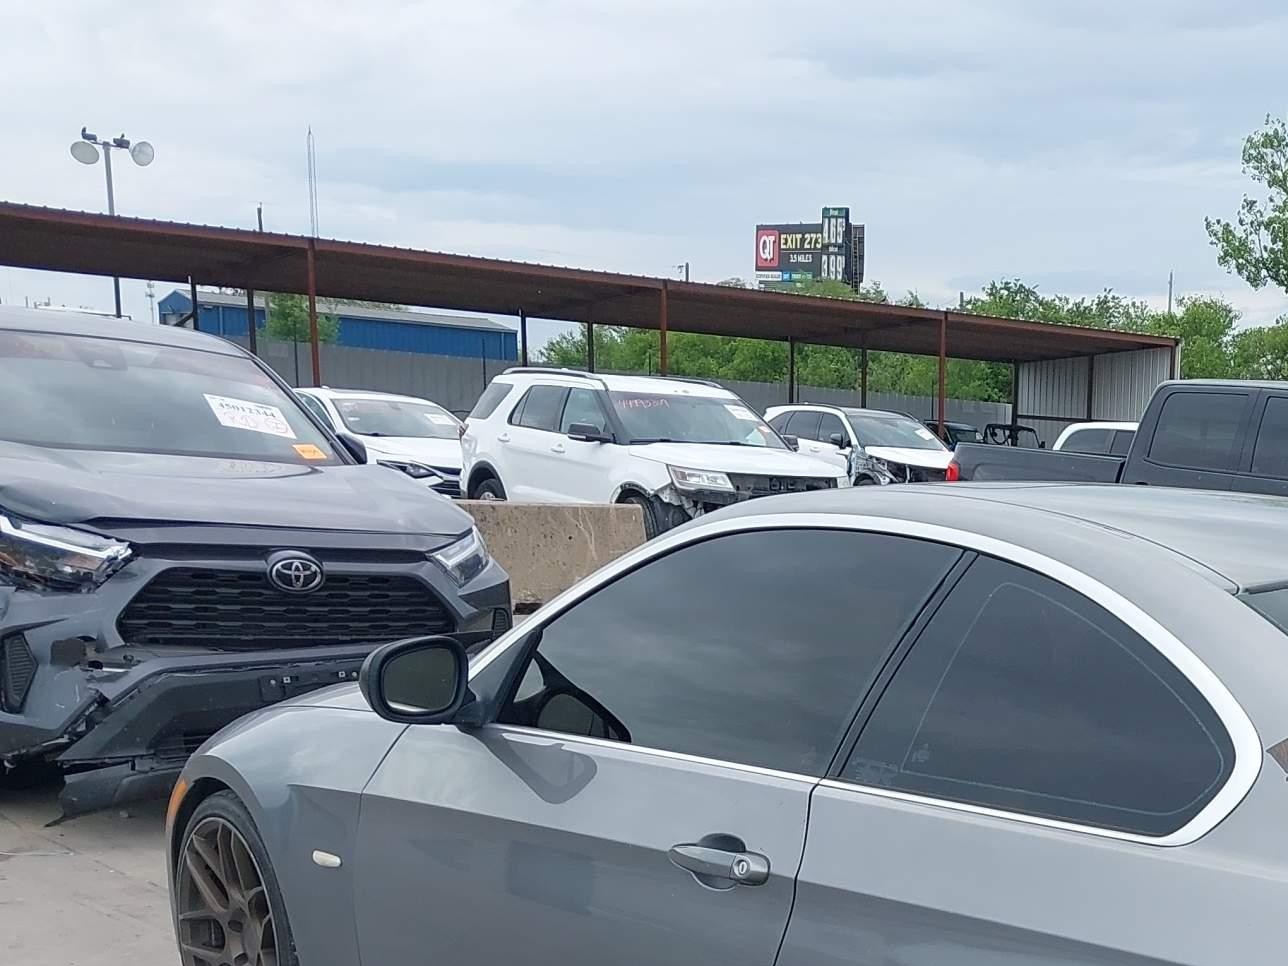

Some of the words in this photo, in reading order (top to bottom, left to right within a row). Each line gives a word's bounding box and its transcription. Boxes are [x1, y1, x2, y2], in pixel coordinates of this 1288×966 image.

[759, 235, 775, 263] QT
[780, 234, 801, 249] EXIT
[804, 233, 821, 249] 273
